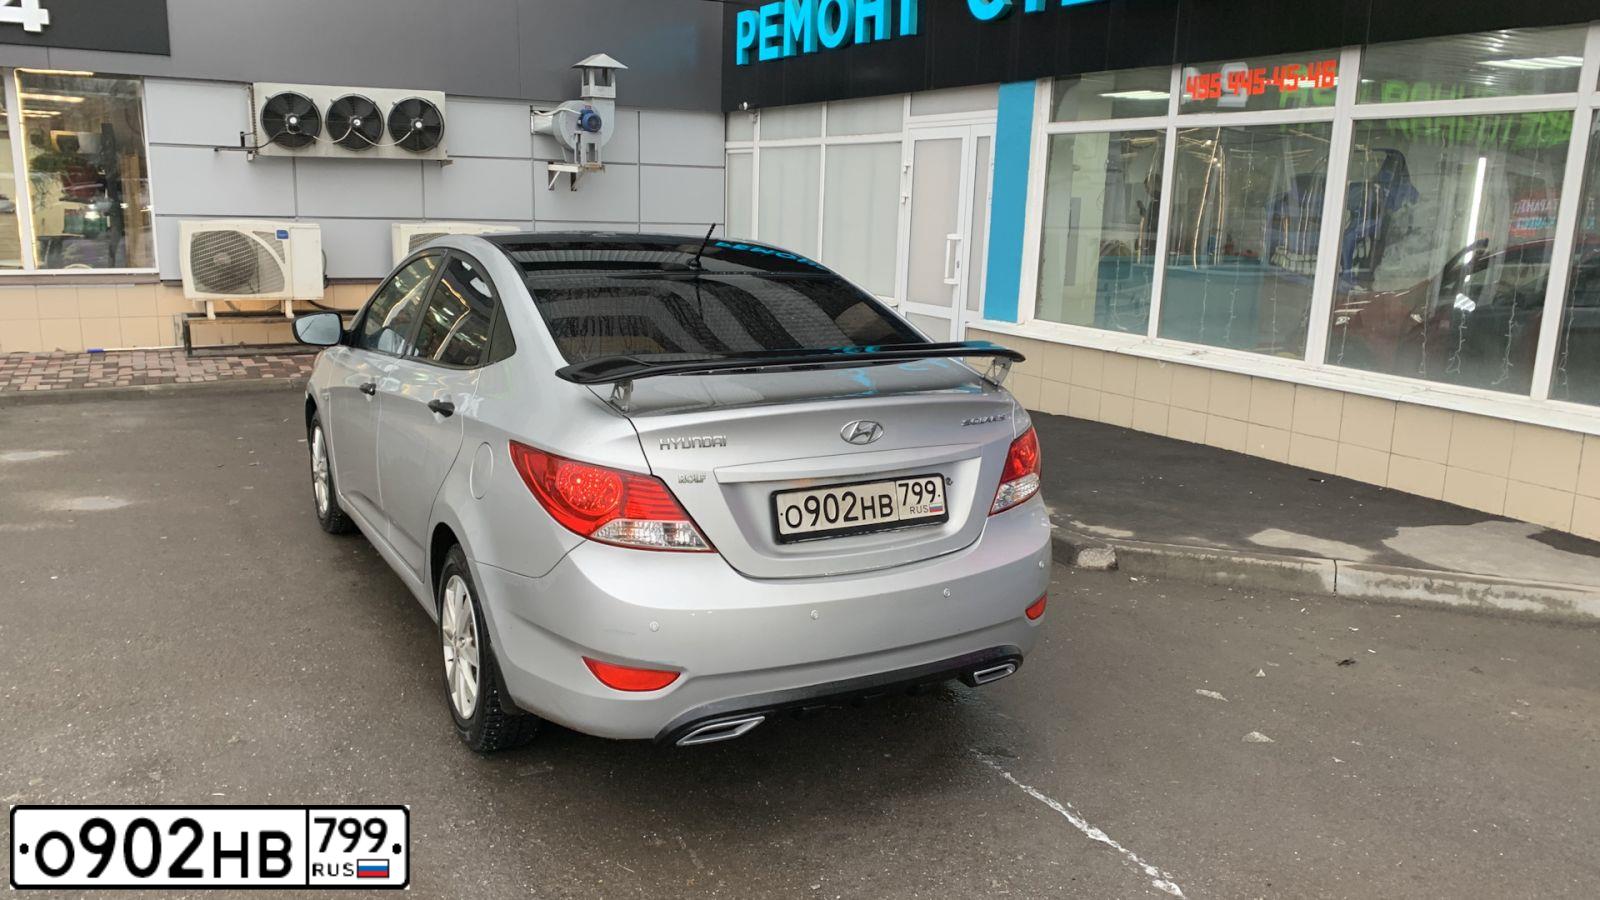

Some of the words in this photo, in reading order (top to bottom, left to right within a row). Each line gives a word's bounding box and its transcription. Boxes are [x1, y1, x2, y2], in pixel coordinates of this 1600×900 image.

[660, 435, 727, 450] HYUNDAI
[898, 480, 936, 506] 799
[909, 504, 929, 514] RUS
